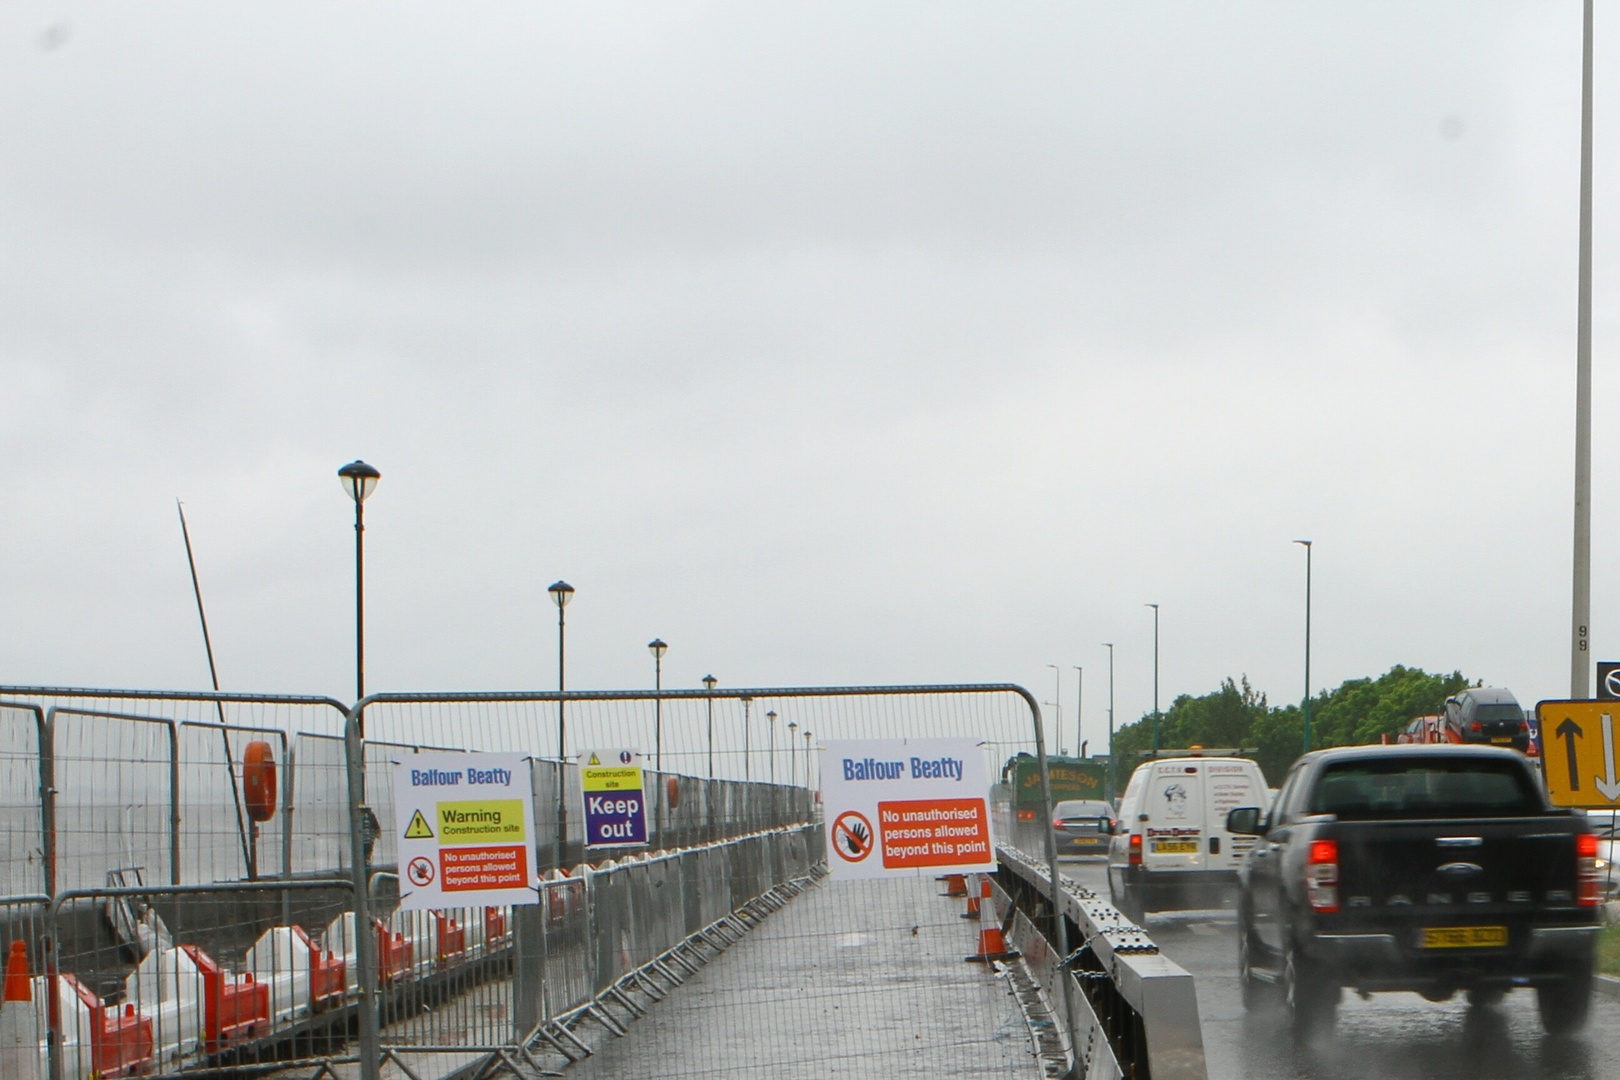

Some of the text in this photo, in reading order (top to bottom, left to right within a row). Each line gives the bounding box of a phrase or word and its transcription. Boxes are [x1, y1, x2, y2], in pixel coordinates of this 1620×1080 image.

[1579, 625, 1587, 650] 99
[411, 767, 513, 787] Balfour Beatty
[586, 770, 636, 779] Construction
[842, 756, 963, 781] Balfour Beatty
[605, 781, 620, 789] site
[589, 796, 639, 818] Keep
[883, 807, 978, 823] No unauthorised
[442, 809, 502, 825] Warning
[443, 823, 520, 836] Construction site
[600, 820, 634, 838] out
[884, 824, 979, 843] persons allowed
[444, 850, 517, 863] No unauthorised
[885, 840, 987, 860] beyond this point
[445, 861, 517, 876] persons allowed
[445, 872, 521, 887] beyond this point
[1348, 889, 1572, 907] RANGER
